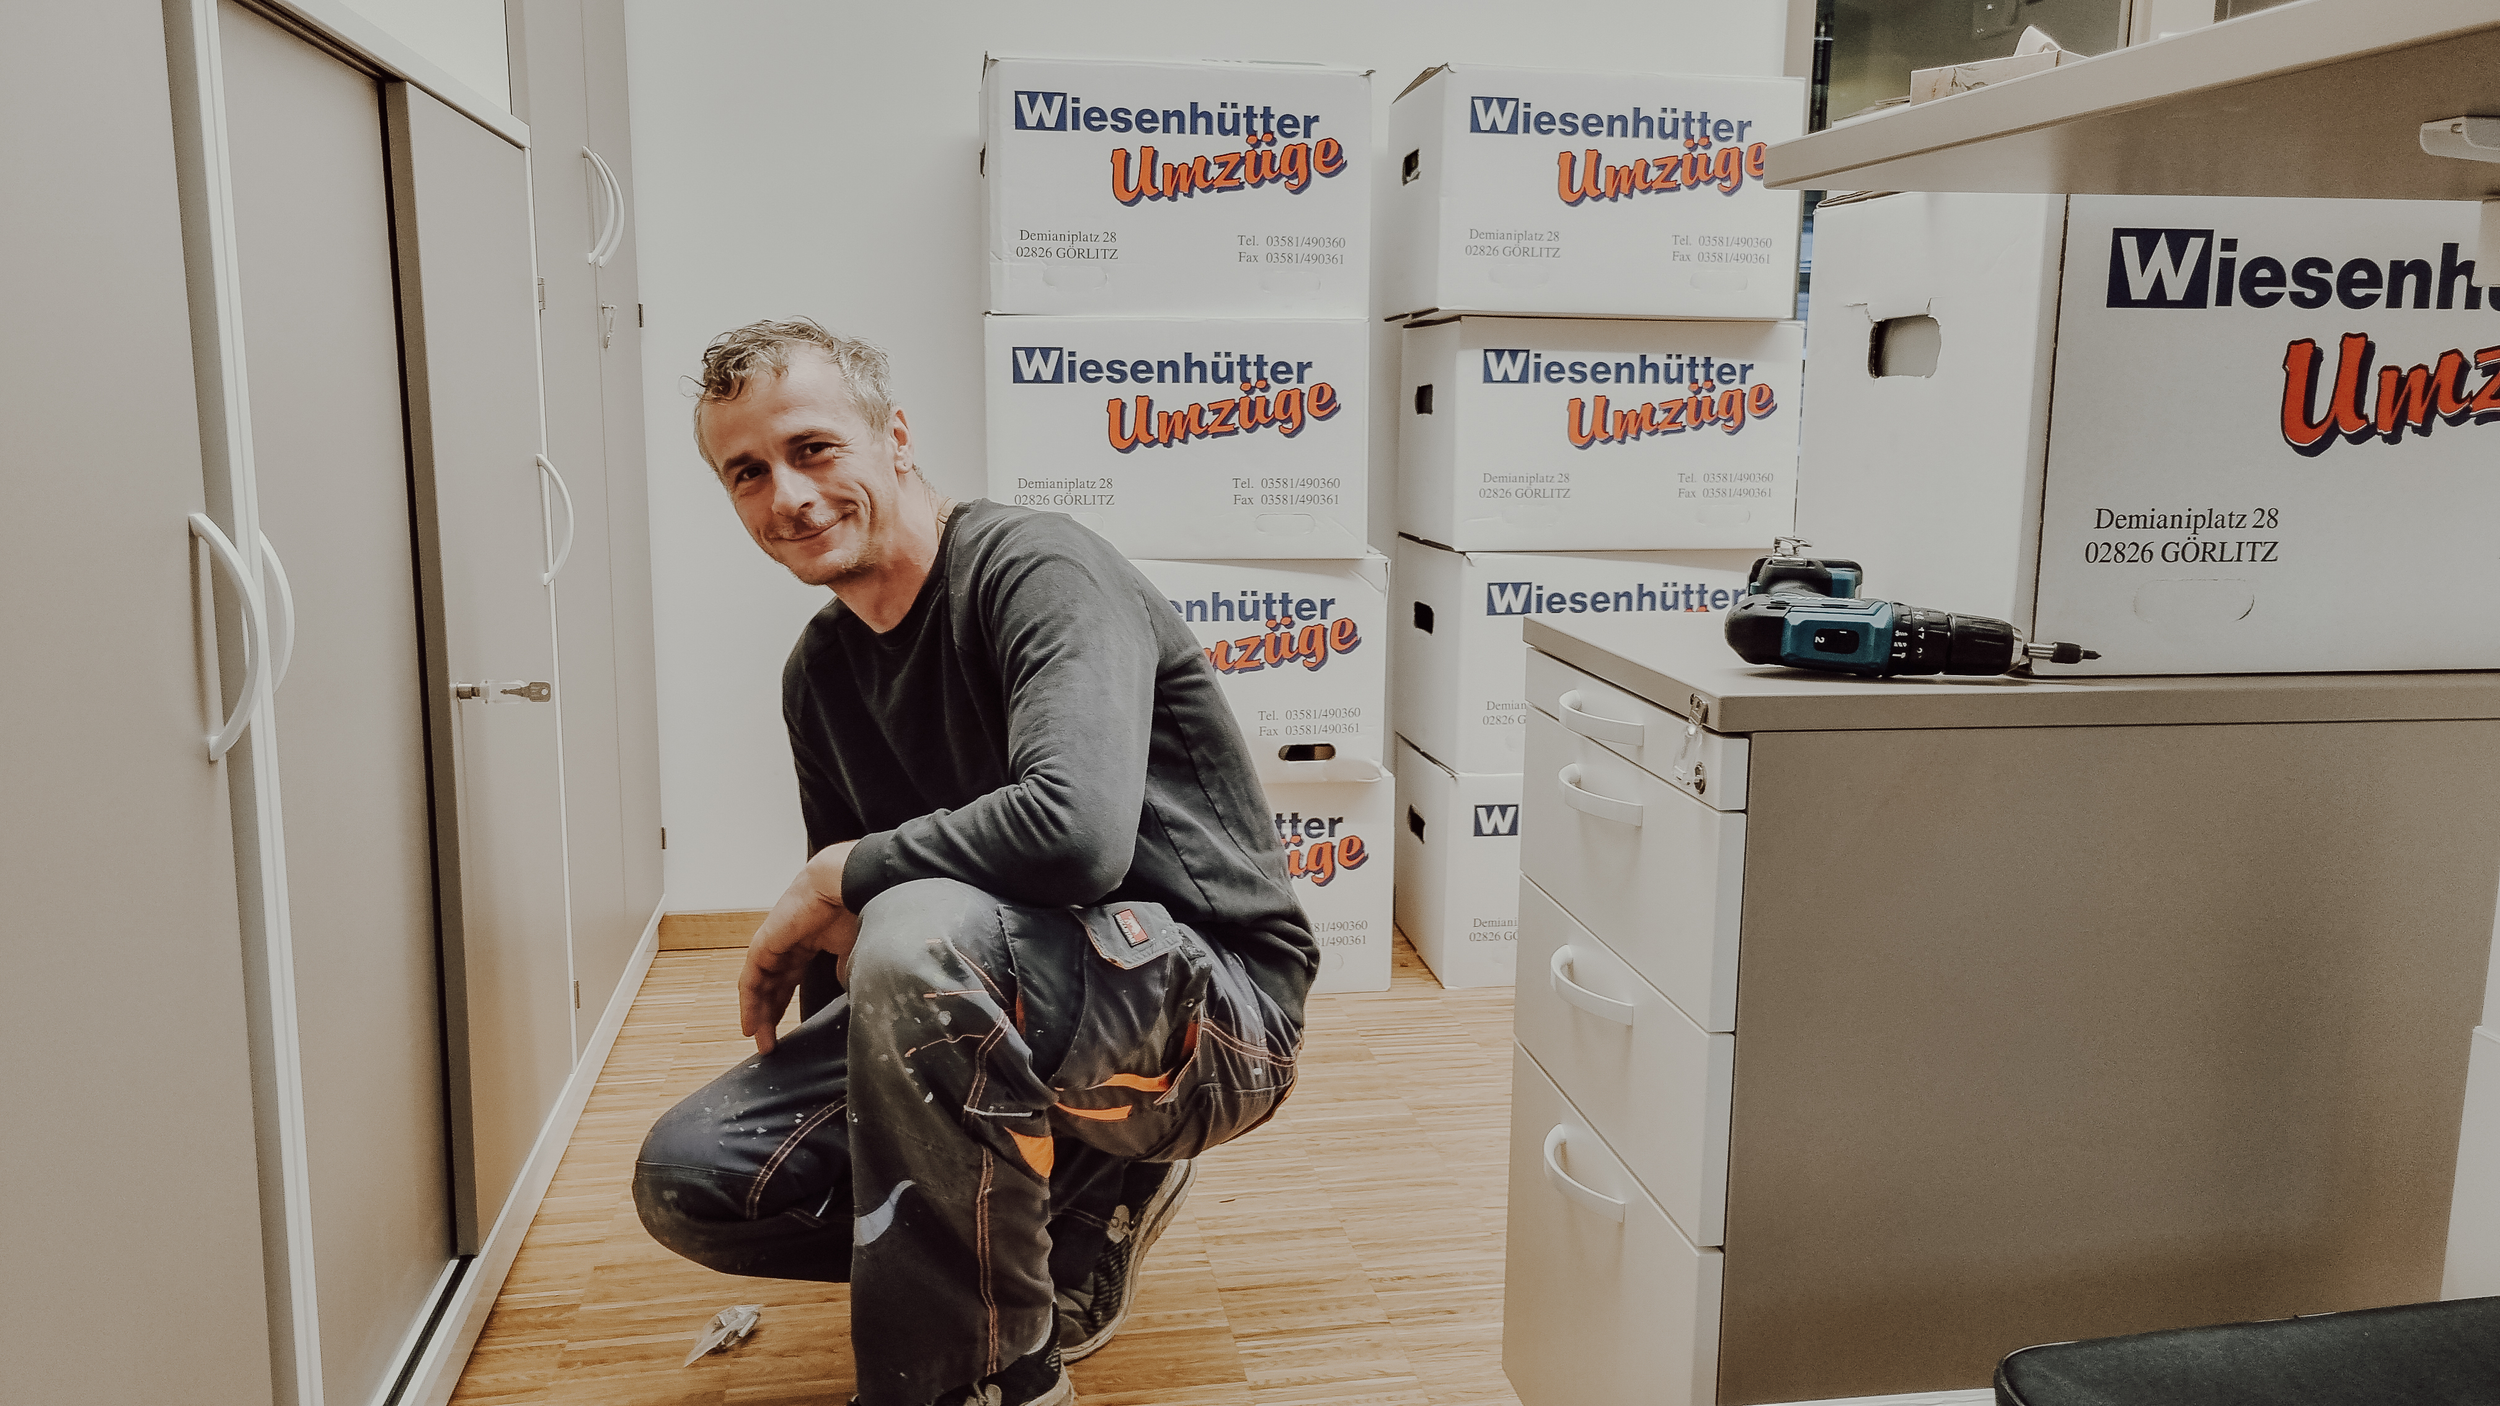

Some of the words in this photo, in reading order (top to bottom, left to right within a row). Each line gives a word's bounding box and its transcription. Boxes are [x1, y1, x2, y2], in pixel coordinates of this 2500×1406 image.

[1014, 90, 1320, 139] Wiesenhütter
[1470, 95, 1752, 143] Wiesenhütter
[1110, 132, 1347, 207] Umzüge
[1557, 138, 1767, 207] Umzüge
[1019, 229, 1100, 245] Demianiplatz
[1102, 231, 1117, 244] 28
[1237, 234, 1259, 247] Tel.
[1265, 235, 1346, 249] 03581/490360
[1468, 228, 1544, 245] Demianiplatz
[1546, 230, 1560, 242] 28
[1671, 234, 1692, 247] Tel.
[1698, 235, 1773, 249] 03581/490360
[1015, 245, 1053, 259] 02826
[1055, 244, 1119, 260] GÖRLITZ
[1238, 251, 1259, 263] Fax
[1265, 251, 1344, 265] 03581/490361
[1464, 244, 1500, 257] 02826
[1502, 243, 1561, 259] GÖRLITZ
[1672, 250, 1692, 262] Fax
[1697, 251, 1770, 265] 03581/490361
[1012, 346, 1313, 385] Wiesenhütter
[1482, 348, 1755, 385] Wiesenhütter
[1106, 378, 1342, 455] Umzüge
[1566, 378, 1778, 451] Umzüge
[1017, 477, 1097, 493] Demianiplatz
[1098, 477, 1114, 490] 28
[1231, 477, 1254, 489] Tel.
[1260, 477, 1341, 490] 03581/490360
[1482, 472, 1555, 486] Demianiplatz
[1557, 472, 1570, 484] 28
[1676, 472, 1696, 484] Tel.
[1702, 472, 1774, 484] 03581/490360
[1013, 493, 1050, 506] 02826
[1053, 490, 1115, 506] GÖRLITZ
[1233, 493, 1254, 506] Fax
[1260, 493, 1339, 506] 03581/490361
[1478, 487, 1513, 499] 02826
[1514, 485, 1571, 499] GÖRLITZ
[1677, 487, 1697, 499] Fax
[1702, 487, 1772, 499] 03581/490361
[2093, 507, 2248, 536] Demianiplatz
[2251, 507, 2280, 530] 28
[2084, 541, 2155, 564] 02826
[2160, 536, 2280, 564] GÖRLITZ
[1169, 590, 1336, 623] nhütter
[1486, 581, 1747, 617] Wiesenhütter
[1257, 710, 1279, 721] Tel.
[1285, 707, 1361, 721] 03581/490360
[1482, 714, 1515, 726] 02826
[1258, 725, 1279, 737] Fax
[1284, 722, 1359, 736] 03581/490361
[1312, 919, 1369, 933] 81/490360
[1468, 931, 1502, 942] 02826
